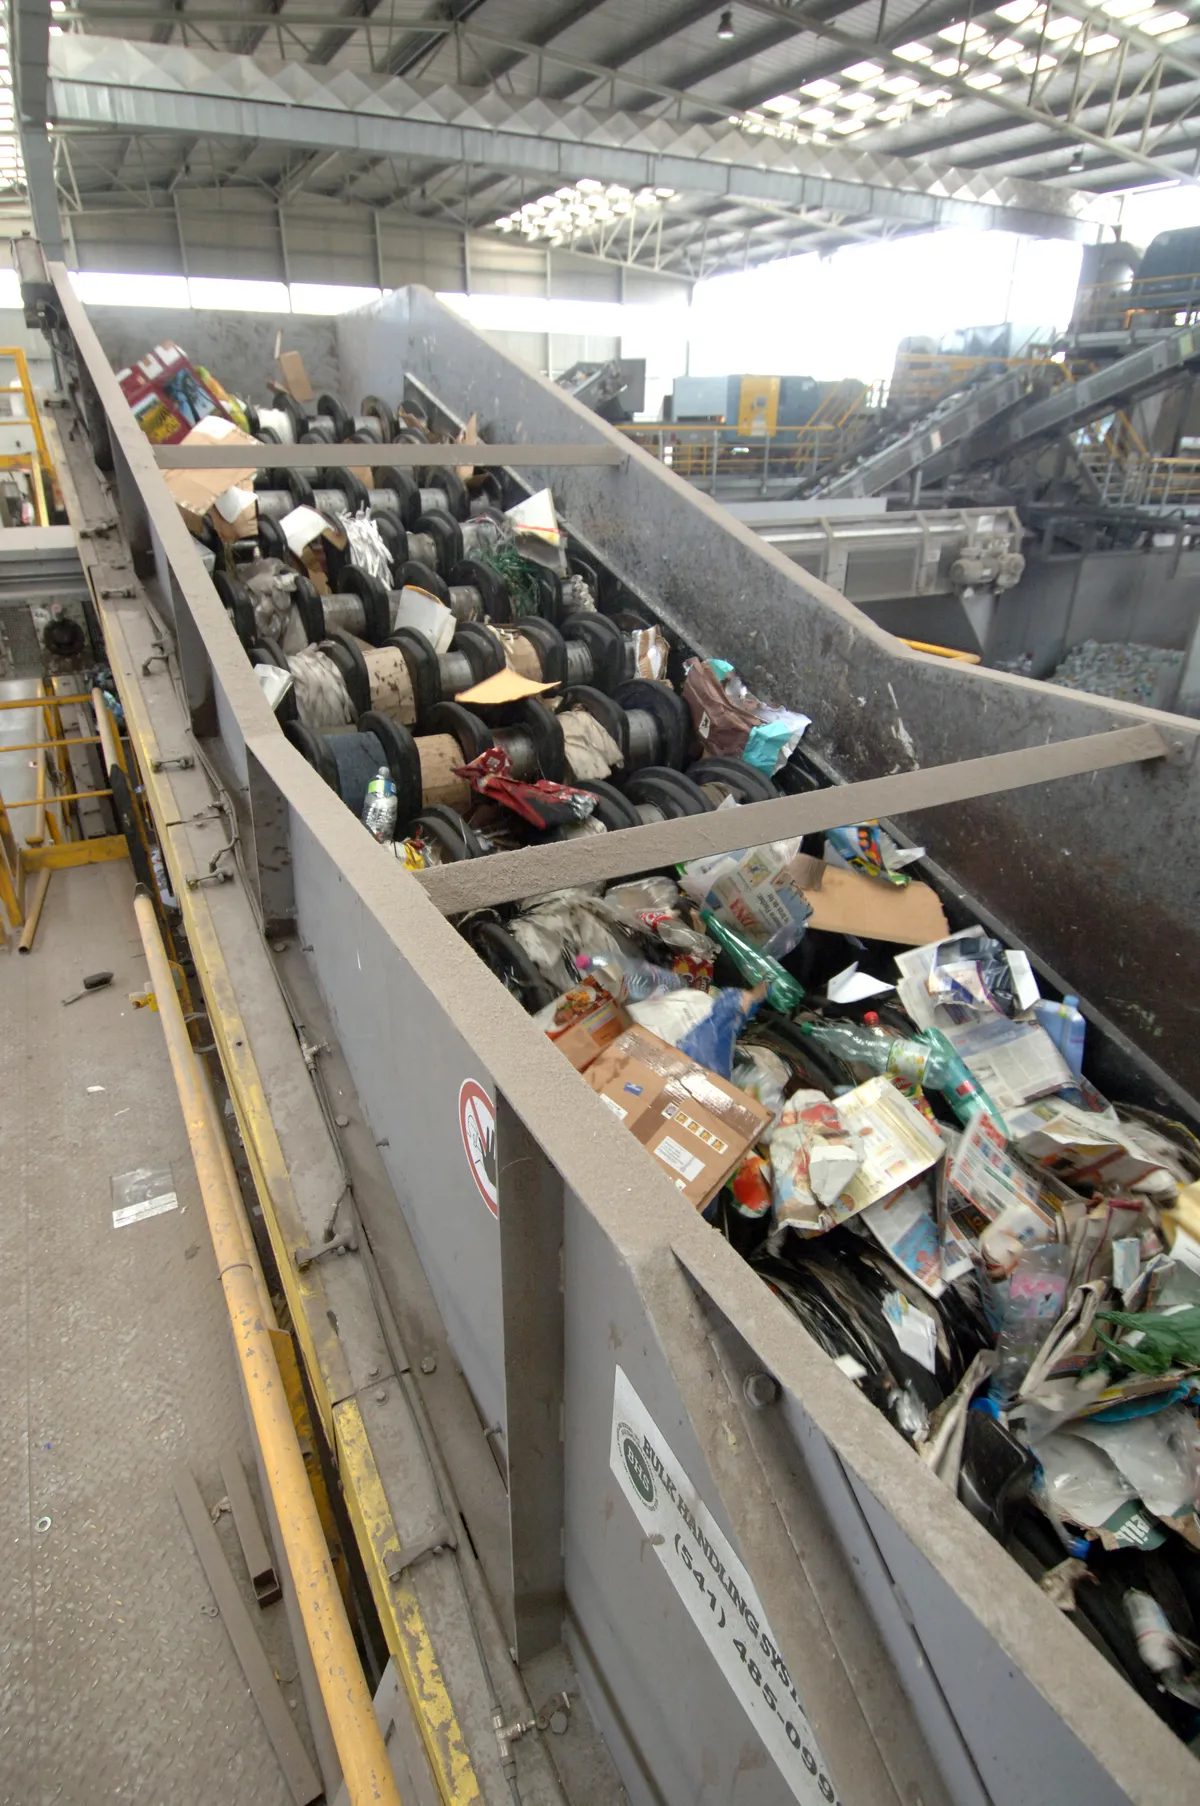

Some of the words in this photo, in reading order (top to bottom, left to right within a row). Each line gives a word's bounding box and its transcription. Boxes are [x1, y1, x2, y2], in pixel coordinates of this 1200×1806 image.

[729, 897, 757, 926] DNA
[626, 1446, 650, 1492] BHS
[642, 1434, 677, 1502] BULK
[676, 1494, 760, 1640] HANDLING
[759, 1632, 807, 1717] SYS
[674, 1532, 726, 1629] (541)
[732, 1637, 842, 1806] 485-099
